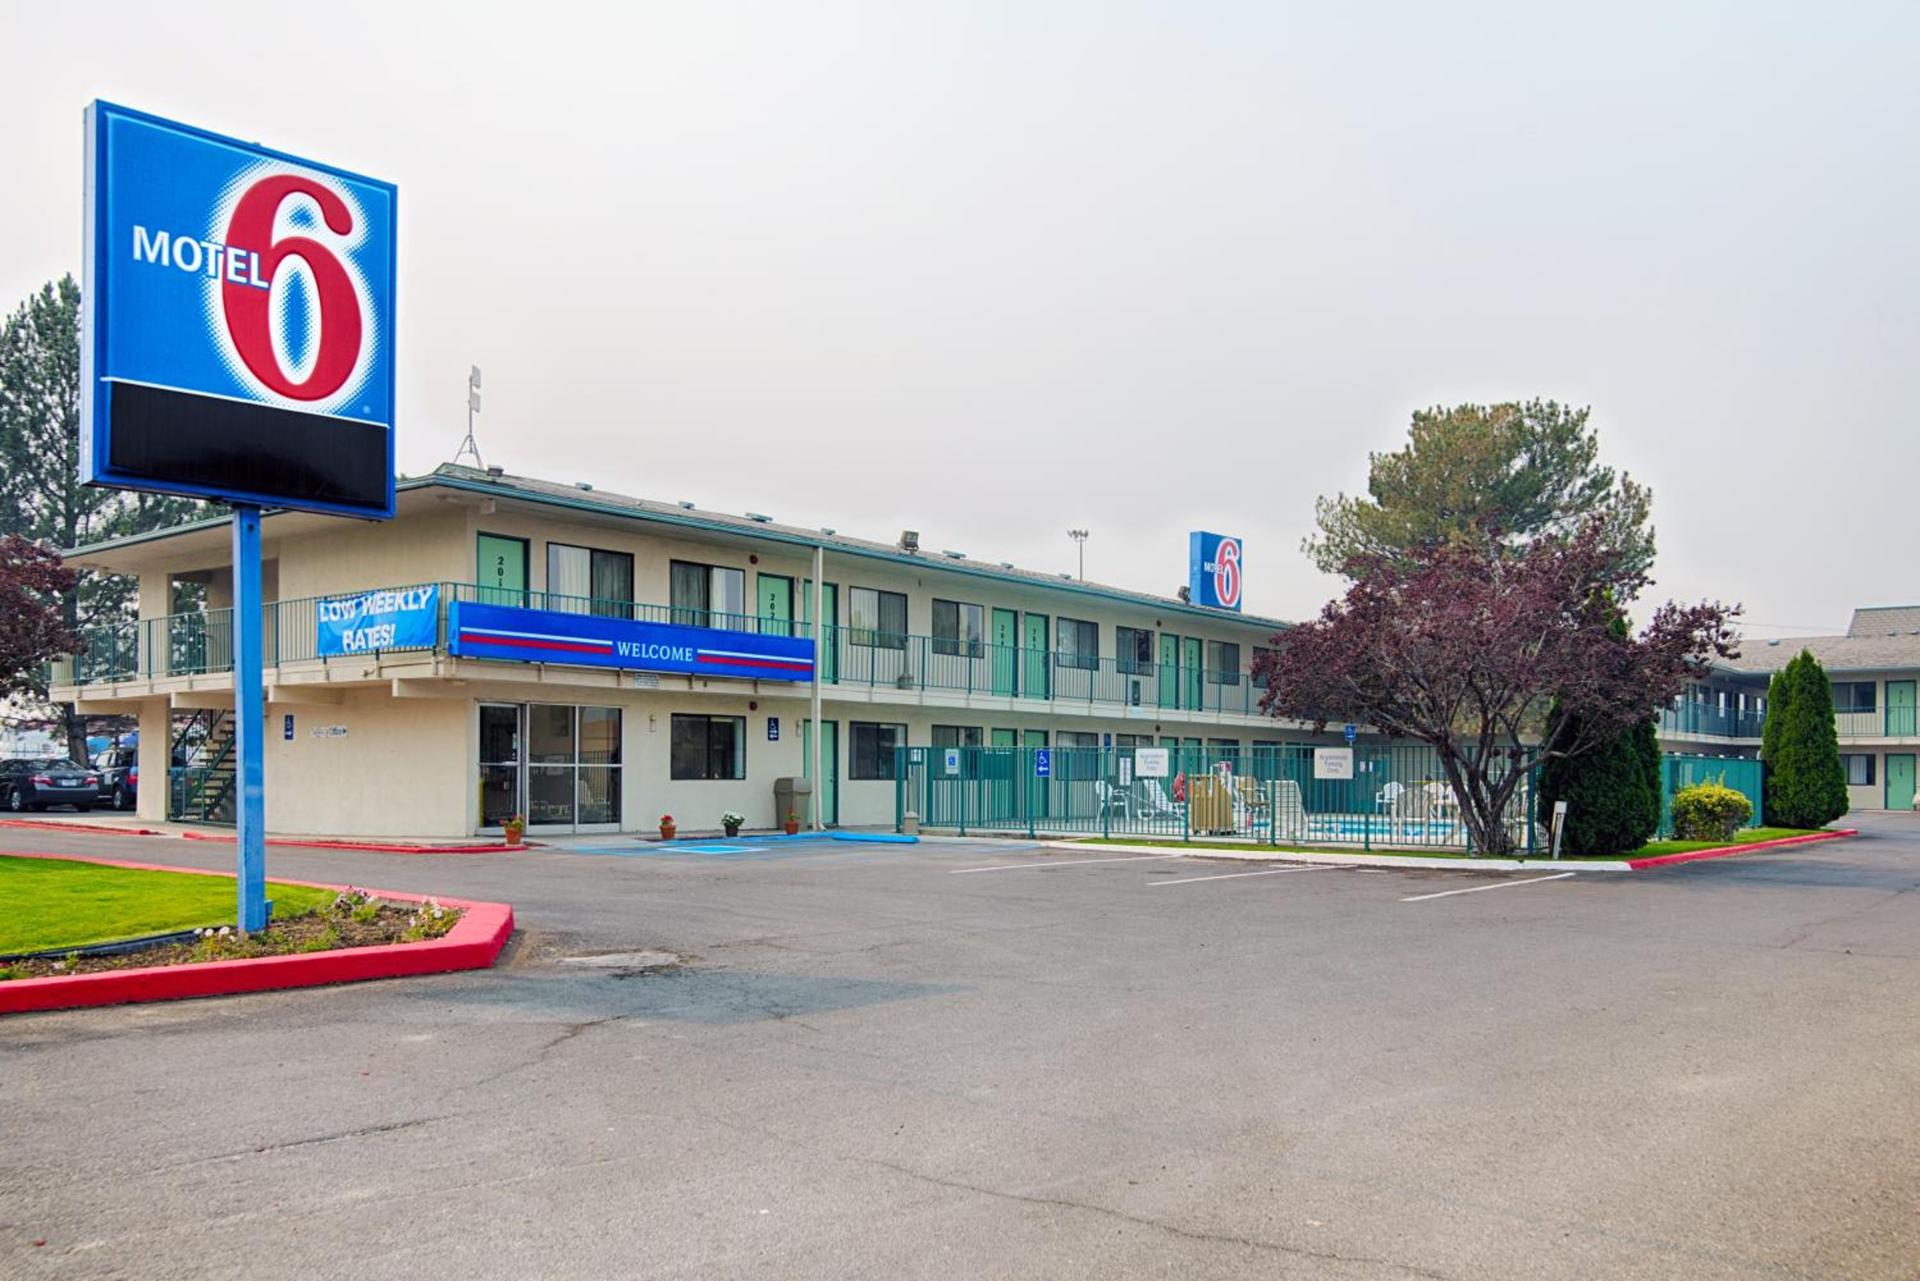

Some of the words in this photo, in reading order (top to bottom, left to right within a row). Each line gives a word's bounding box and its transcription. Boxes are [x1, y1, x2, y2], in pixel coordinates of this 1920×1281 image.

[133, 226, 268, 289] MOTEL
[222, 174, 362, 402] 6
[1216, 540, 1239, 606] 6
[319, 600, 356, 622] LOW
[362, 589, 433, 616] WEEKLY
[342, 624, 396, 652] RATES!
[617, 641, 693, 662] WELCOME
